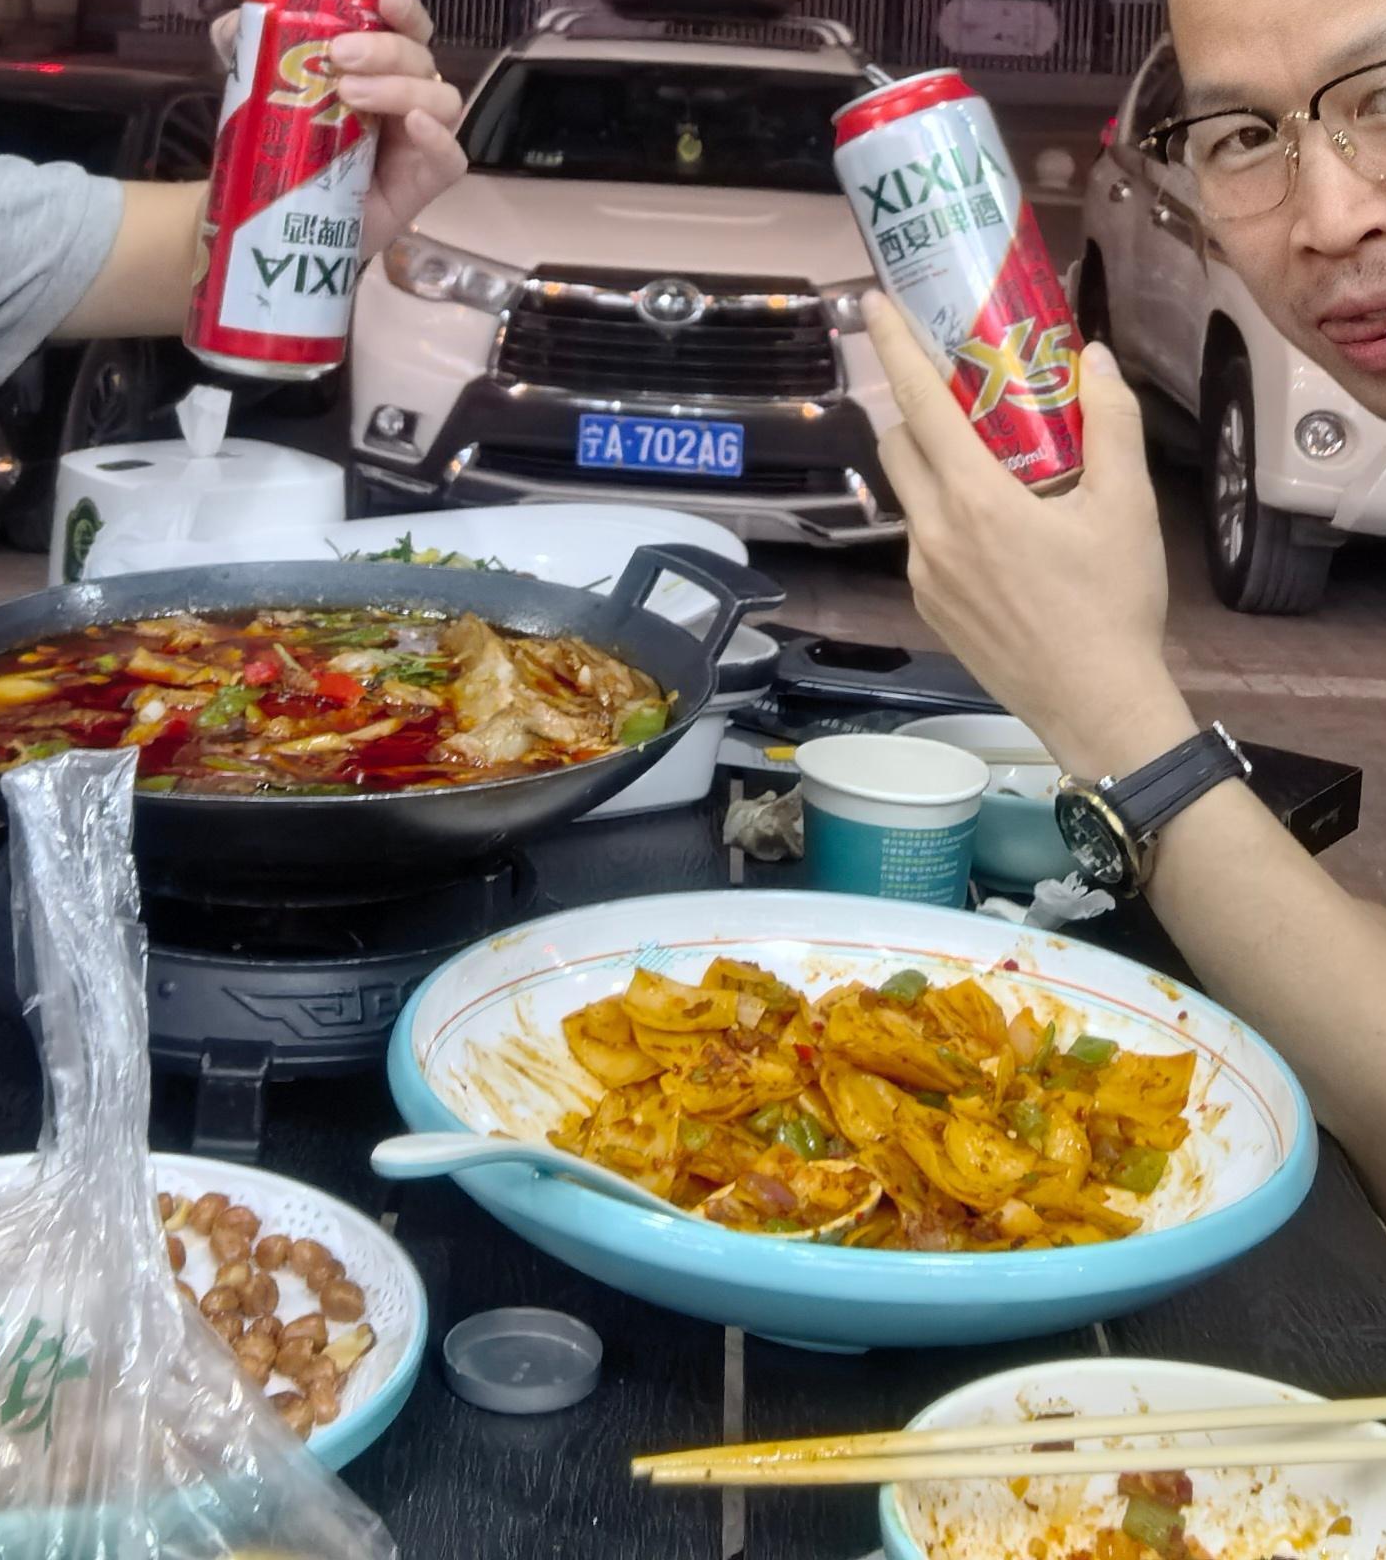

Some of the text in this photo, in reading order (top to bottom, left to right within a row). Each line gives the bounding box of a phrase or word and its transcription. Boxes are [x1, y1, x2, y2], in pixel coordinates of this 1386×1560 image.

[859, 145, 1006, 226] XIXIA
[876, 191, 1004, 266] 西夏啤酒
[251, 247, 357, 297] IXIA
[952, 316, 1080, 423] X5
